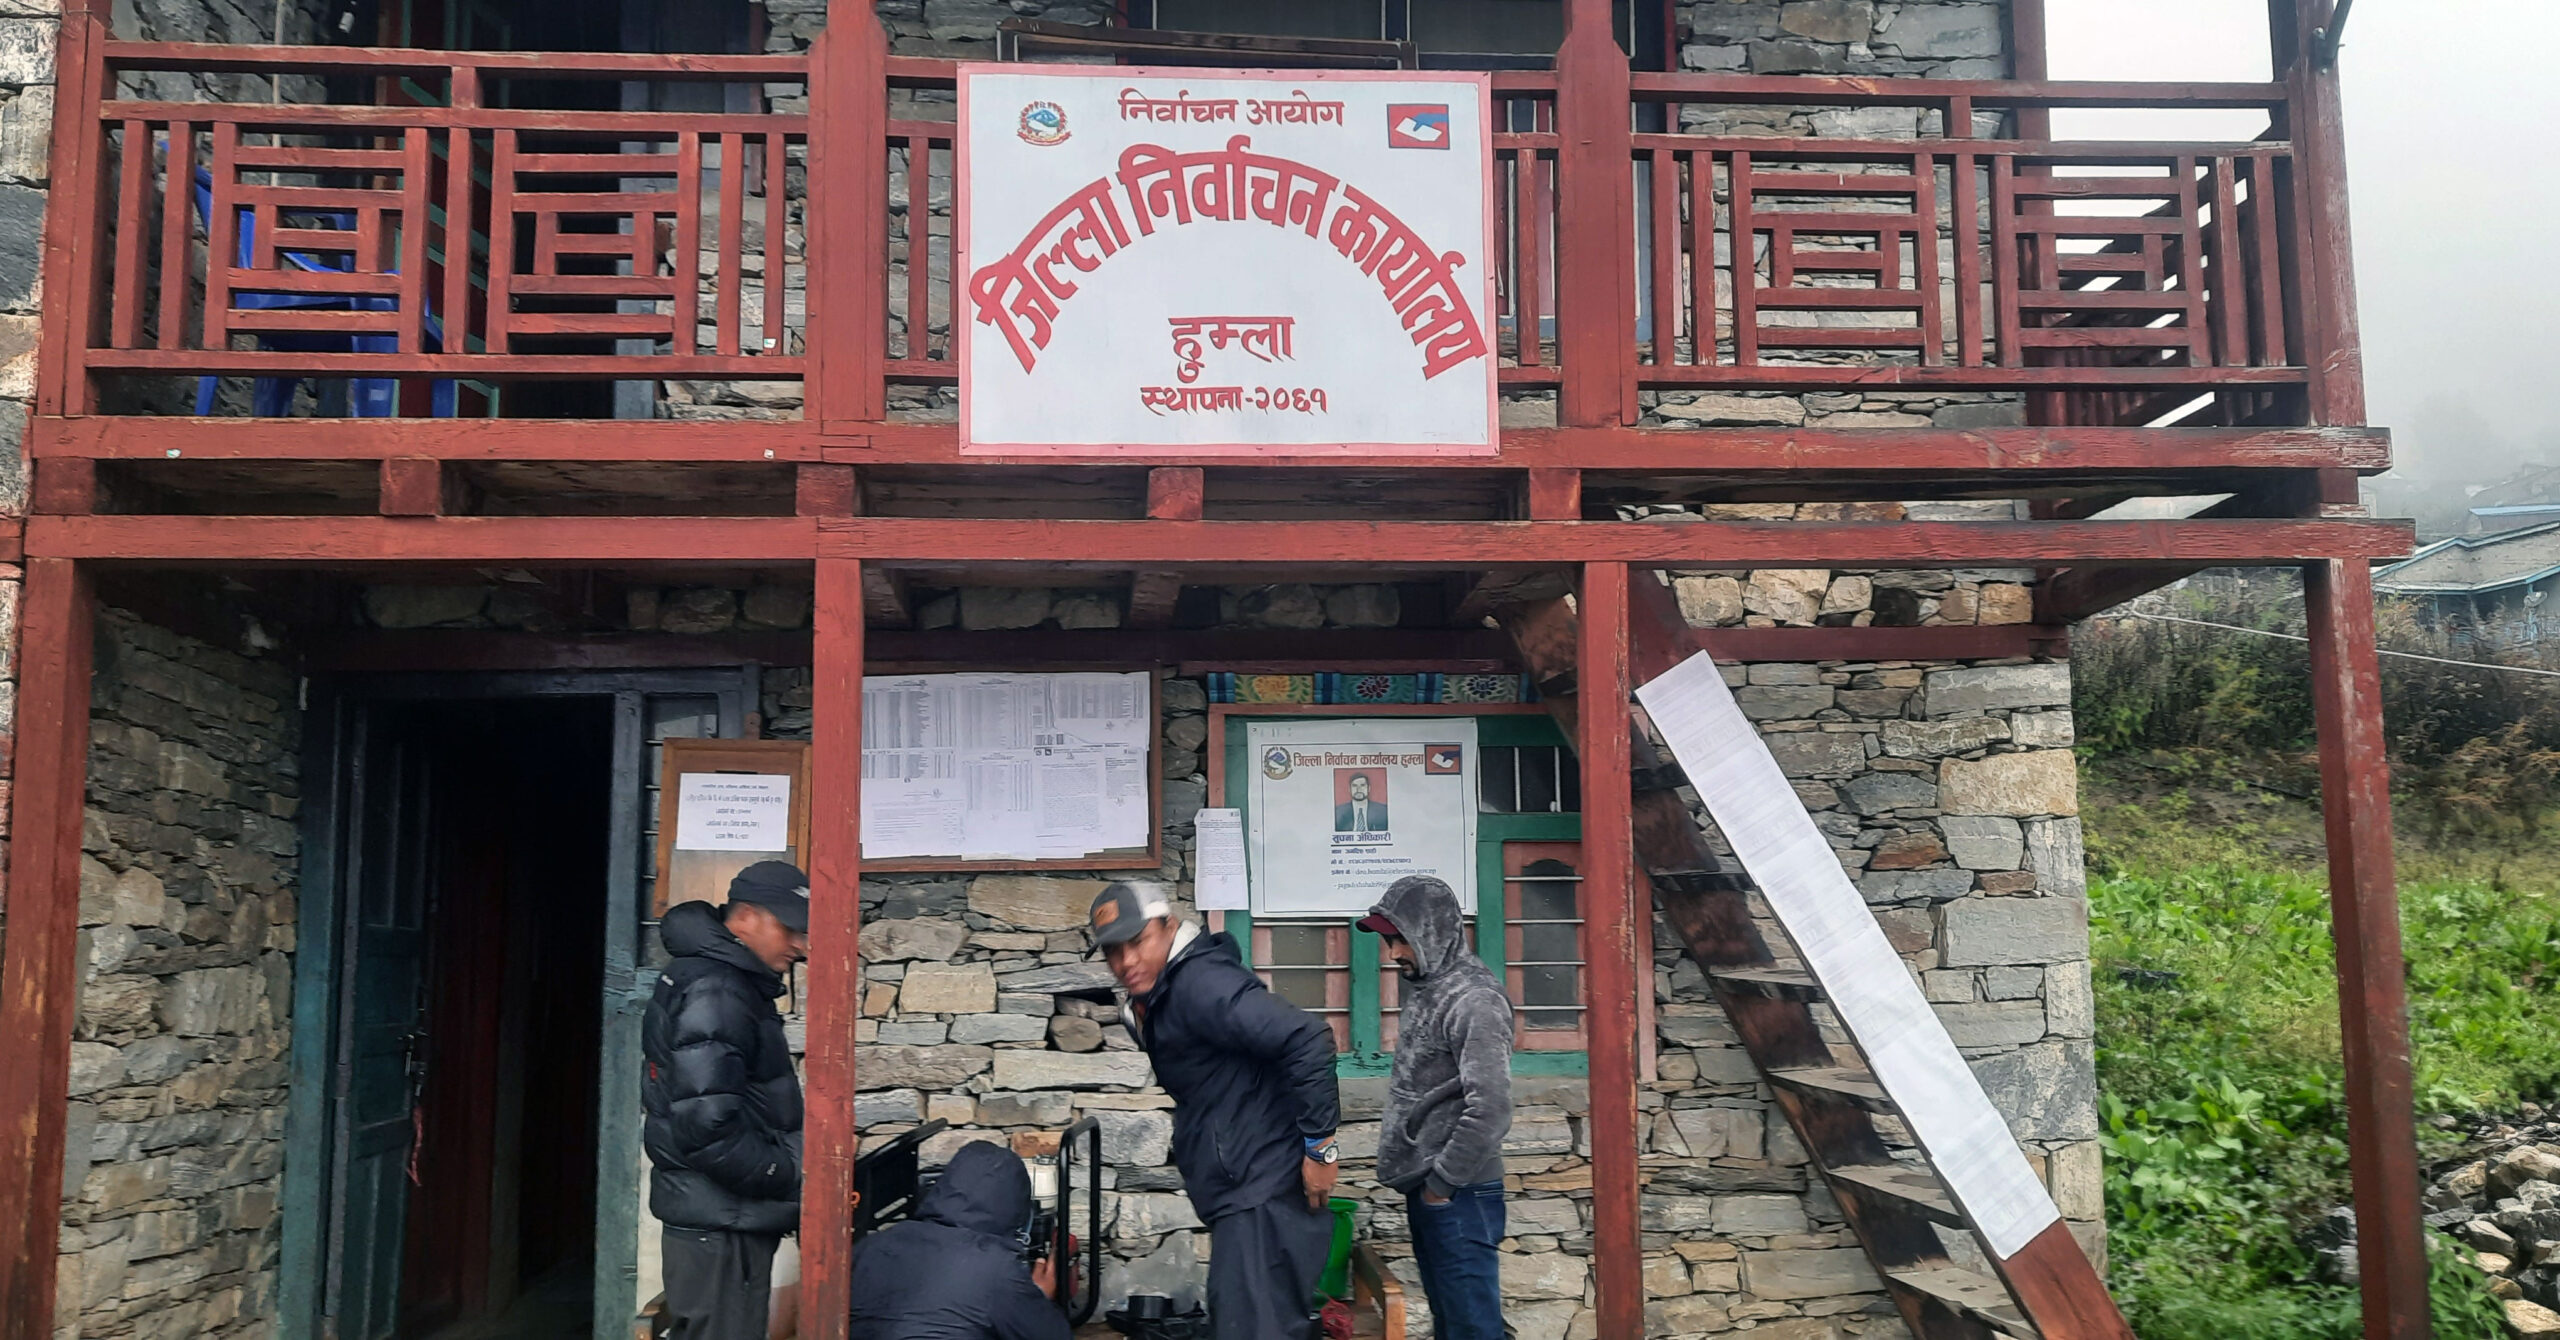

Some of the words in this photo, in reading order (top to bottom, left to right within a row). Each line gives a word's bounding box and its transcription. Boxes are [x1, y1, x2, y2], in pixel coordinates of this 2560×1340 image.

[1118, 87, 1239, 124] निर्वाचन
[1245, 89, 1345, 127] आयोग
[969, 177, 1132, 375] जिल्ला
[1116, 134, 1341, 239] निर्वाचन
[1328, 184, 1488, 381] कार्यालय
[1167, 316, 1296, 383] हुम्ला
[1139, 385, 1329, 415] स्थापना-२०६१
[1293, 752, 1322, 767] जिल्ला
[1324, 752, 1357, 766] निर्वाचन
[1359, 752, 1398, 765] कार्यालय
[1400, 753, 1425, 768] हुम्ला
